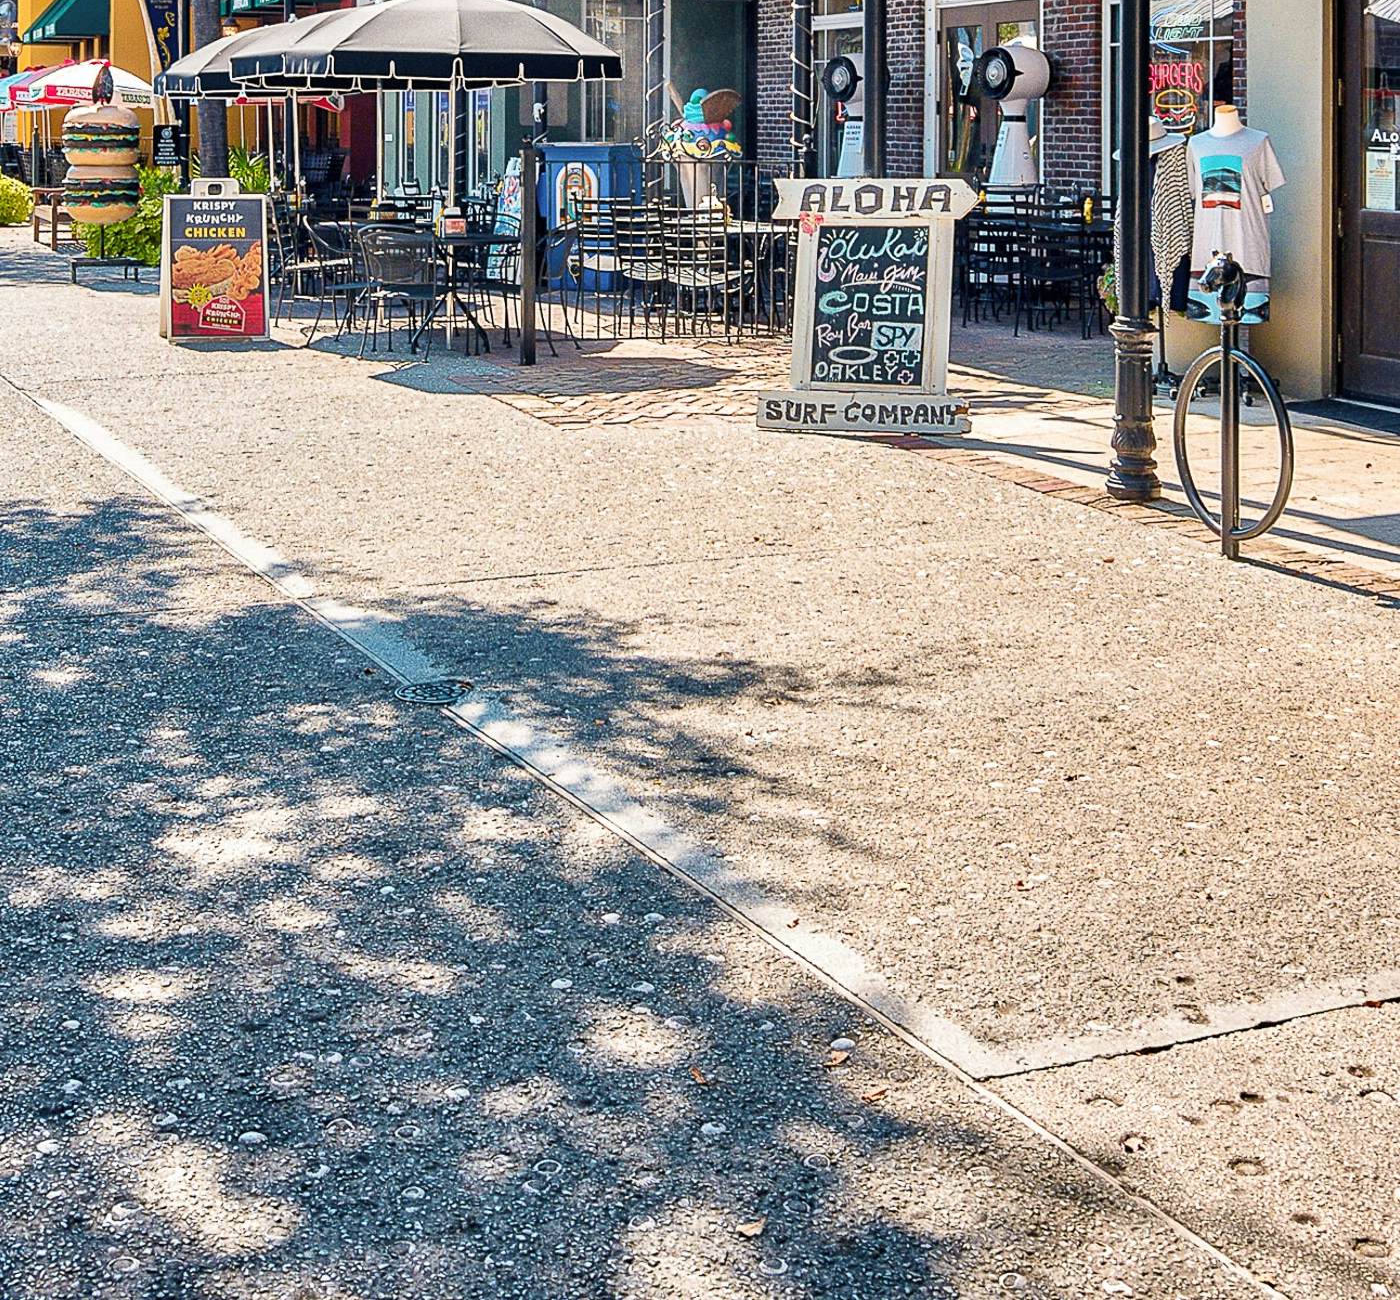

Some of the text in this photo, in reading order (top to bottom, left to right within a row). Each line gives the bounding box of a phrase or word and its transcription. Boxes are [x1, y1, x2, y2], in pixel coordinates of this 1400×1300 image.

[1154, 26, 1204, 40] LIGHT
[1148, 61, 1203, 94] BURGERS
[55, 86, 93, 98] TABASC
[121, 93, 151, 105] TABASCO
[193, 201, 236, 211] KRISPY
[800, 184, 951, 214] ALOHA
[186, 213, 244, 225] KRUNCHY
[185, 227, 246, 238] CHICKEN
[841, 262, 878, 282] Maui
[819, 291, 924, 316] COSTA
[815, 312, 872, 348] Ray Ban
[876, 325, 916, 347] SPY
[815, 361, 898, 381] OAKLEY
[765, 401, 960, 425] SURF COMPANY
